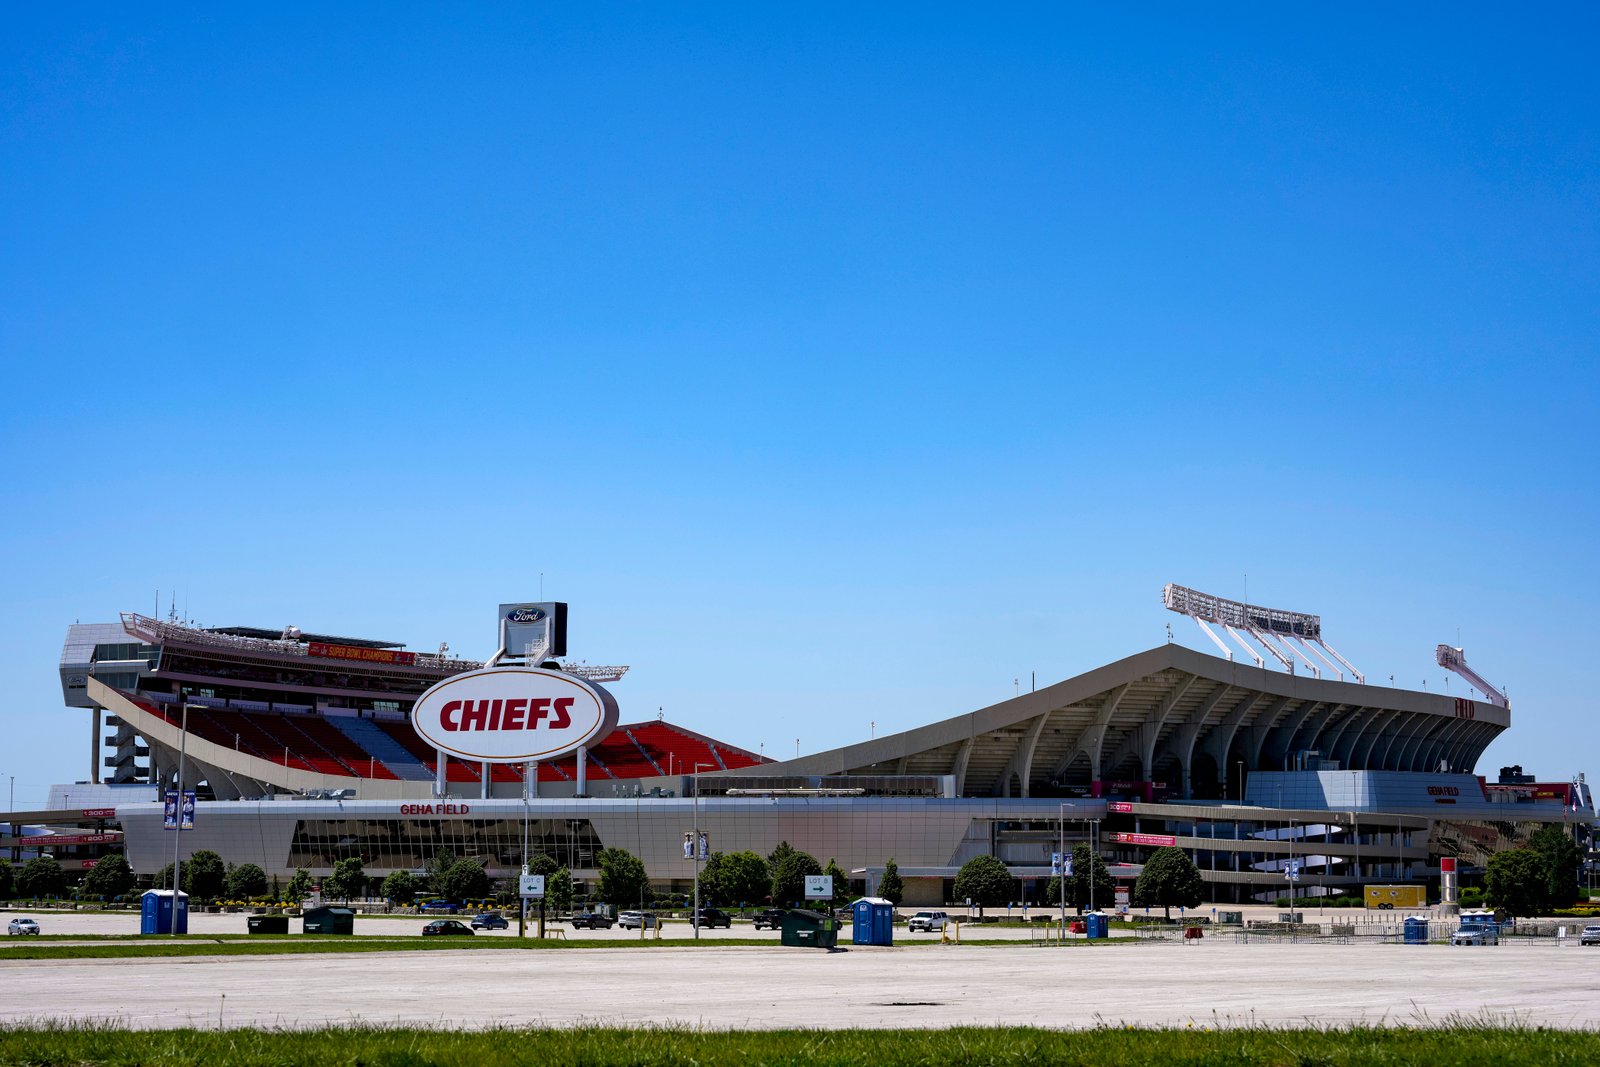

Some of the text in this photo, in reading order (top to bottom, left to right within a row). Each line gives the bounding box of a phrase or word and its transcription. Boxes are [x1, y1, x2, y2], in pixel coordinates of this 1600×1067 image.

[513, 608, 539, 622] Ford
[328, 646, 346, 657] SUPER
[346, 648, 361, 659] BOWL
[362, 649, 394, 662] CHAMPIONS
[439, 697, 575, 732] CHIEFS
[400, 804, 469, 815] GEHA FIELD
